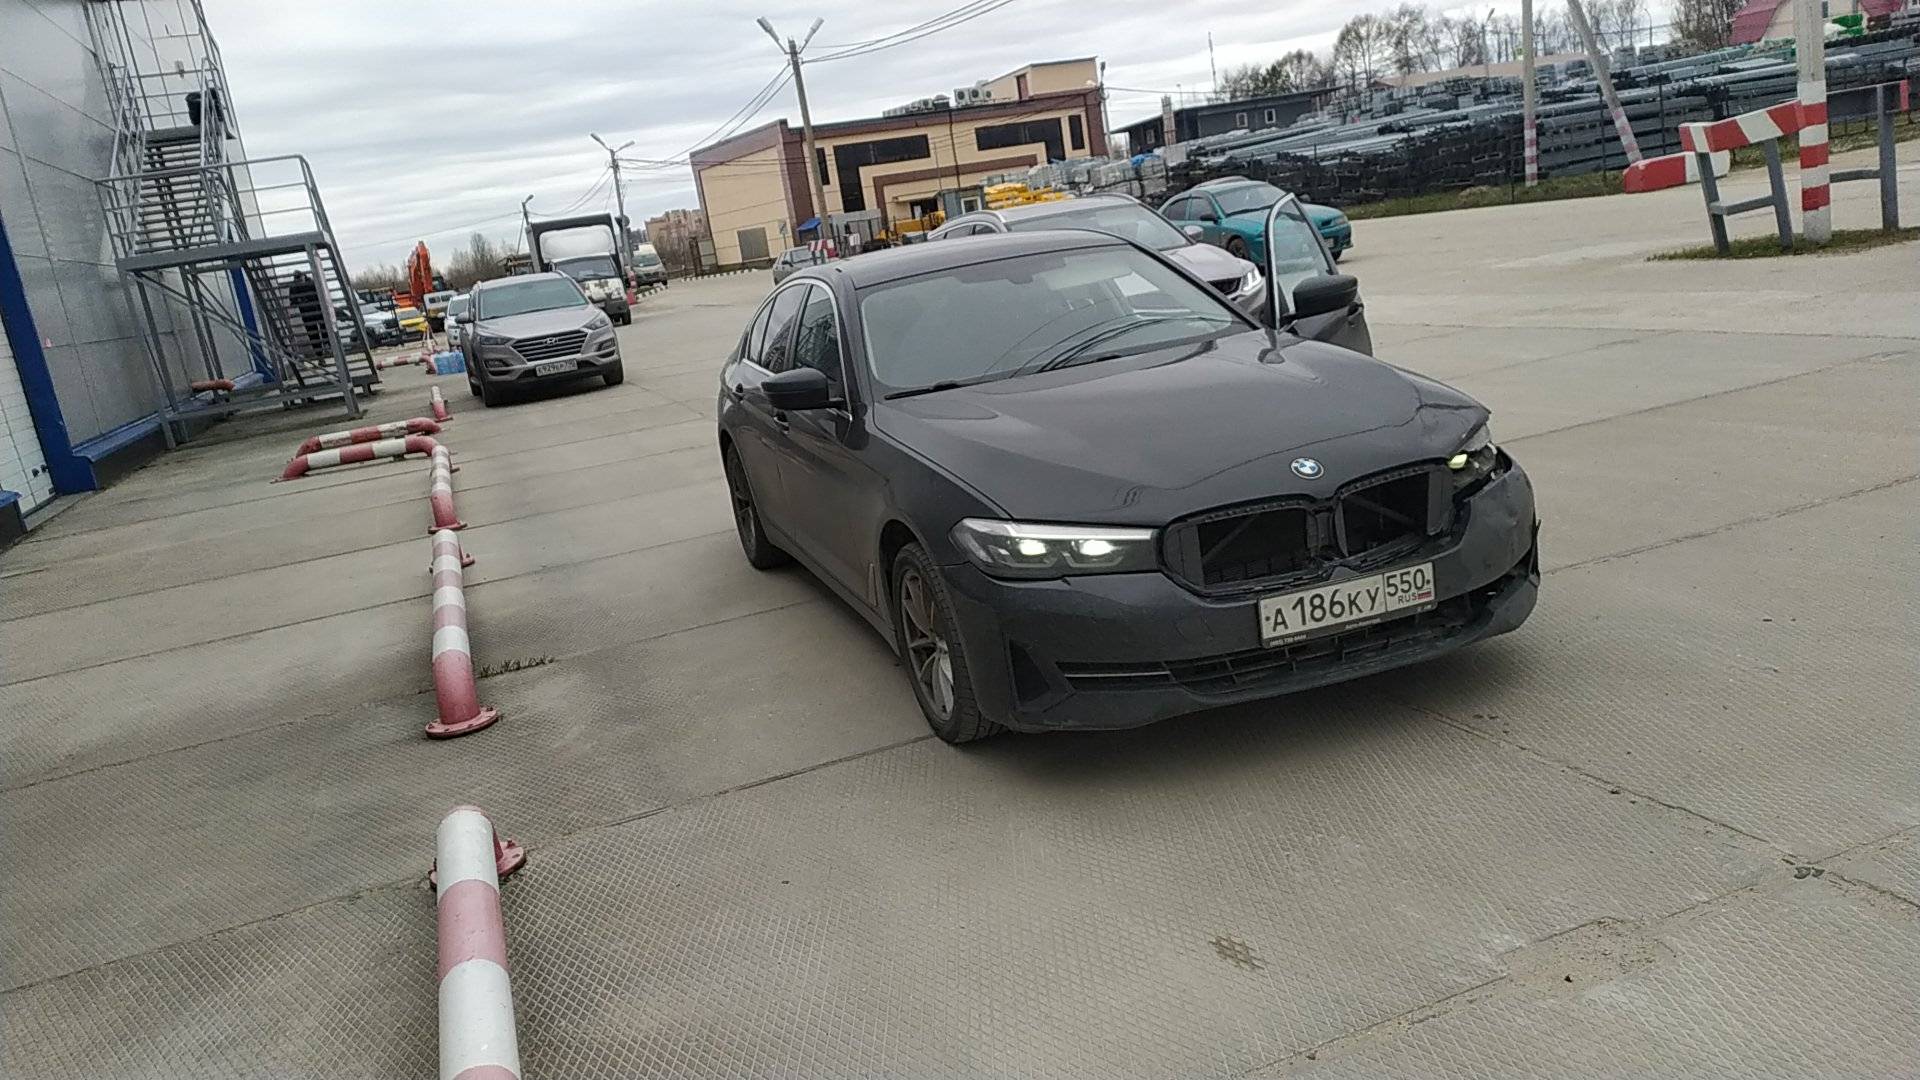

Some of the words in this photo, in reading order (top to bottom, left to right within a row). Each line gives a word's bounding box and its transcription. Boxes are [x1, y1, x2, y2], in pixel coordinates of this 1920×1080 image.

[1272, 587, 1380, 632] А186КУ
[1386, 568, 1426, 597] 550
[1397, 593, 1417, 605] RUS
